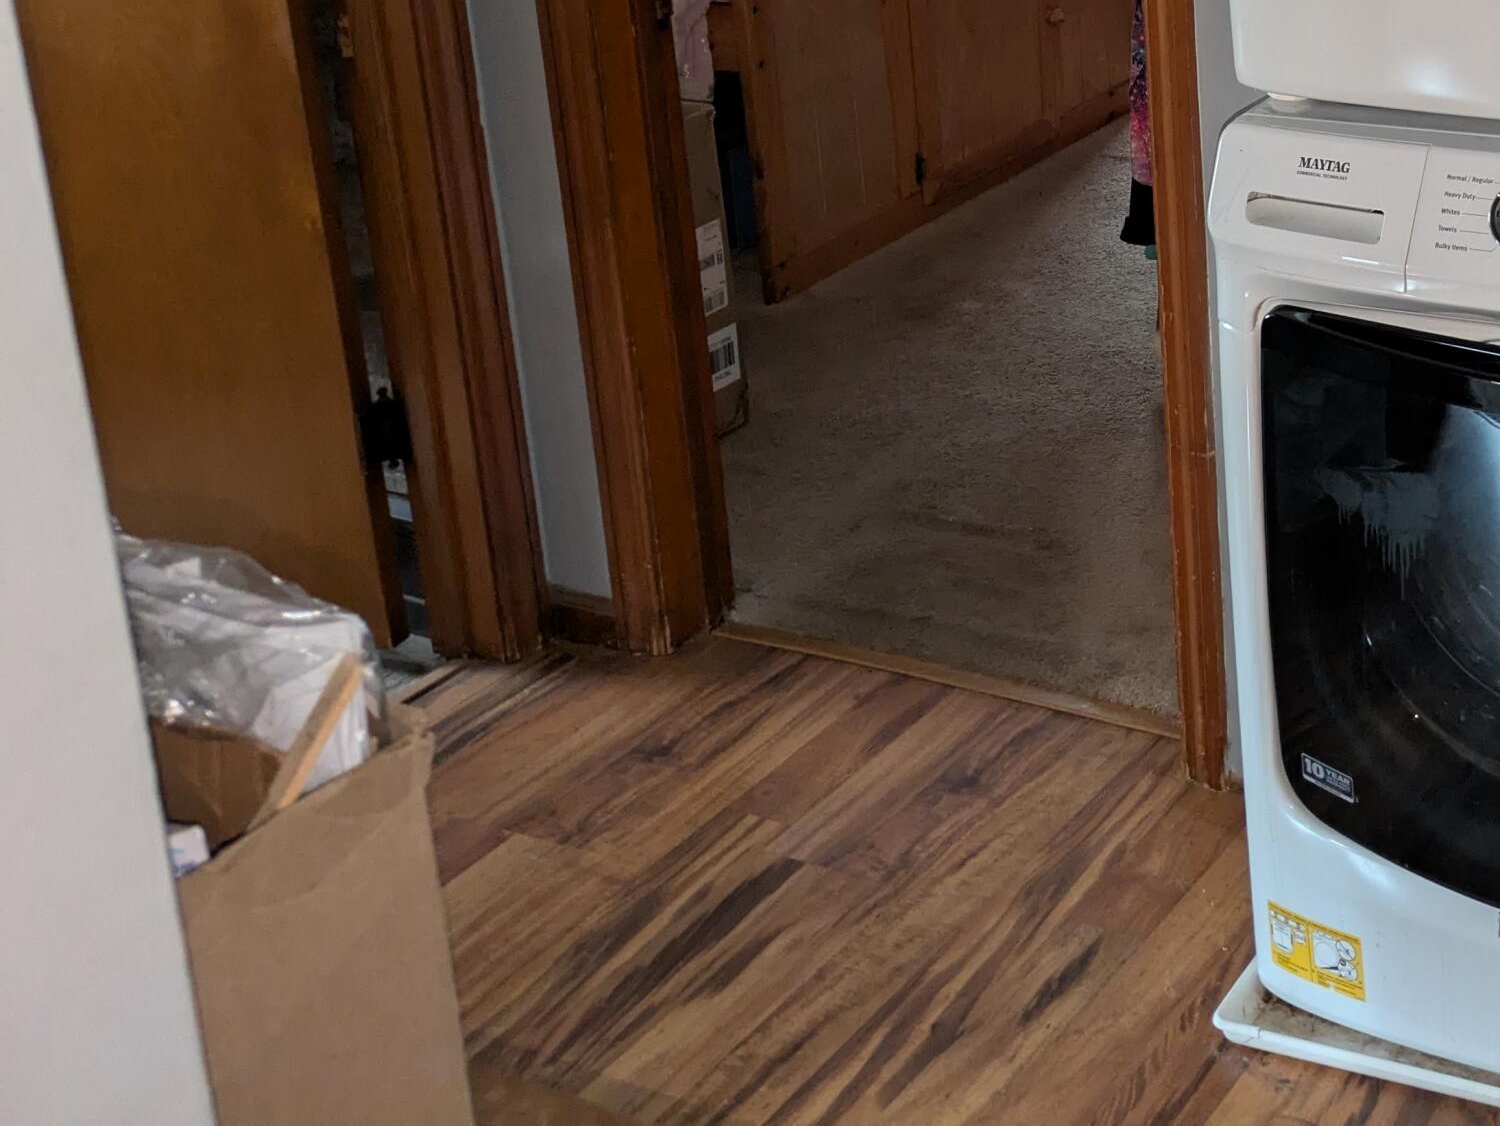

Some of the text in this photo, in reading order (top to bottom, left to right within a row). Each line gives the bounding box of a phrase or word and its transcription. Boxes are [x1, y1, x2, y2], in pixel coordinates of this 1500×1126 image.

[1298, 156, 1350, 174] MAYTAG
[1446, 173, 1494, 185] Normal Regular
[1444, 191, 1476, 201] Heavy Duty
[1441, 207, 1460, 216] Whites
[1438, 225, 1457, 233] Towels
[1434, 242, 1467, 252] Bulky Items
[1304, 757, 1325, 779] 10
[1326, 768, 1350, 785] YEAR
